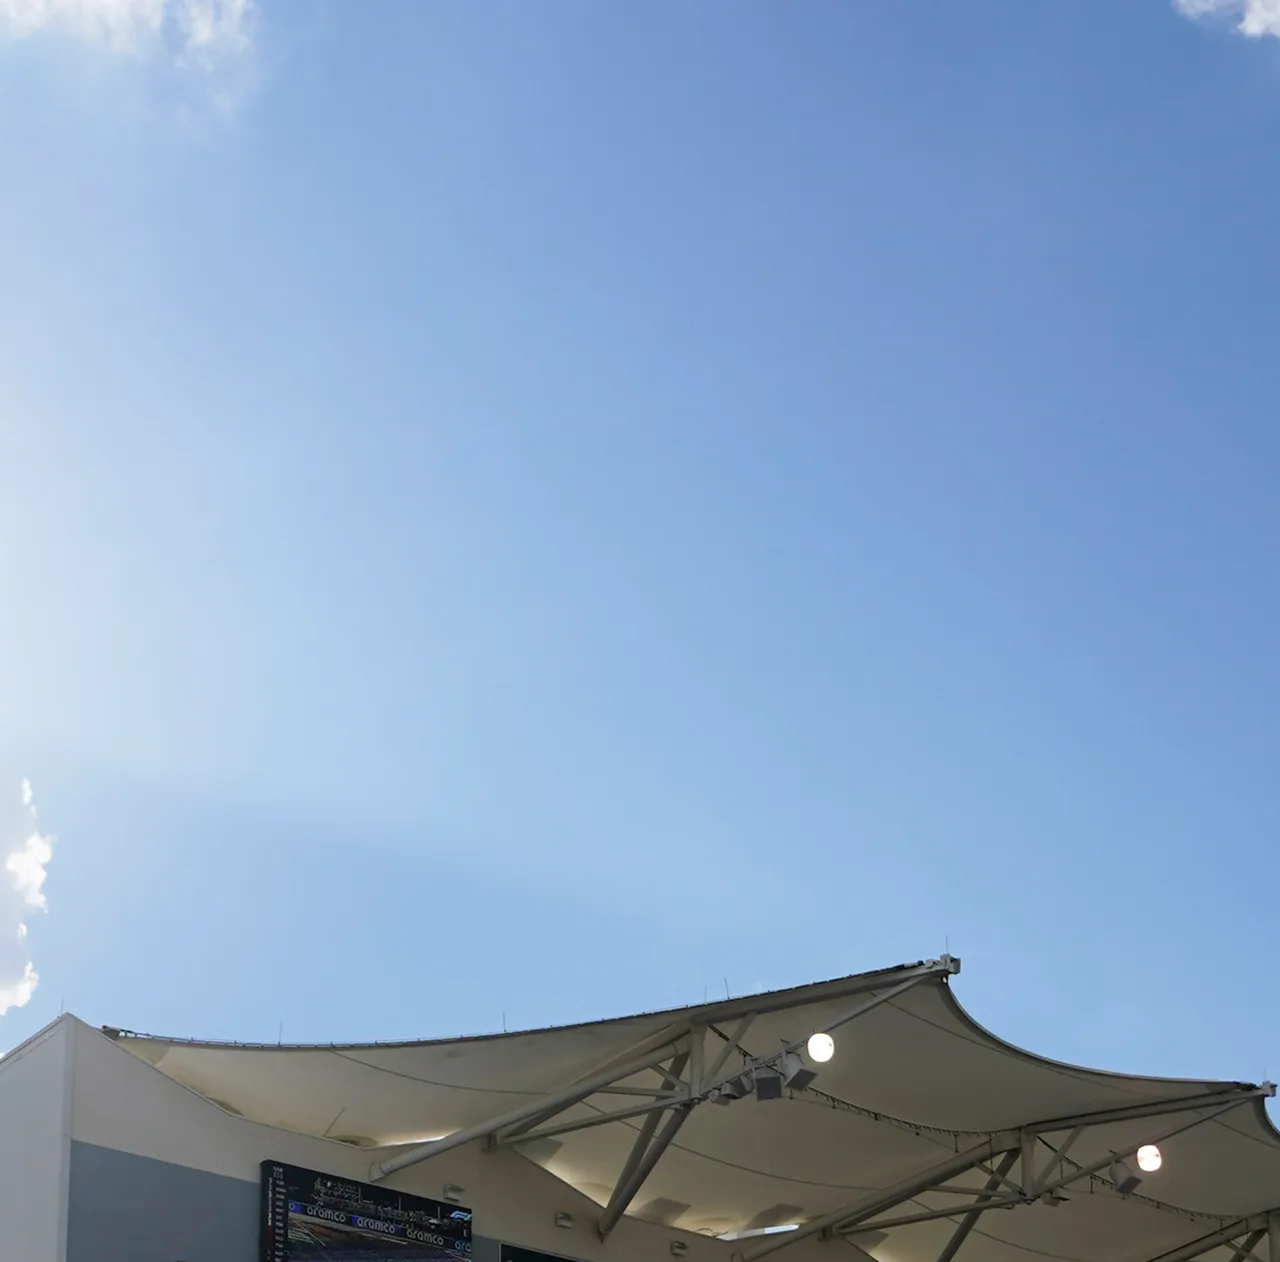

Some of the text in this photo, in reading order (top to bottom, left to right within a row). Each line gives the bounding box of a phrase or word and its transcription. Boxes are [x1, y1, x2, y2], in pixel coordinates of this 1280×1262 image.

[306, 1206, 346, 1223] aramco
[356, 1217, 396, 1235] aramco
[406, 1228, 444, 1246] aramco
